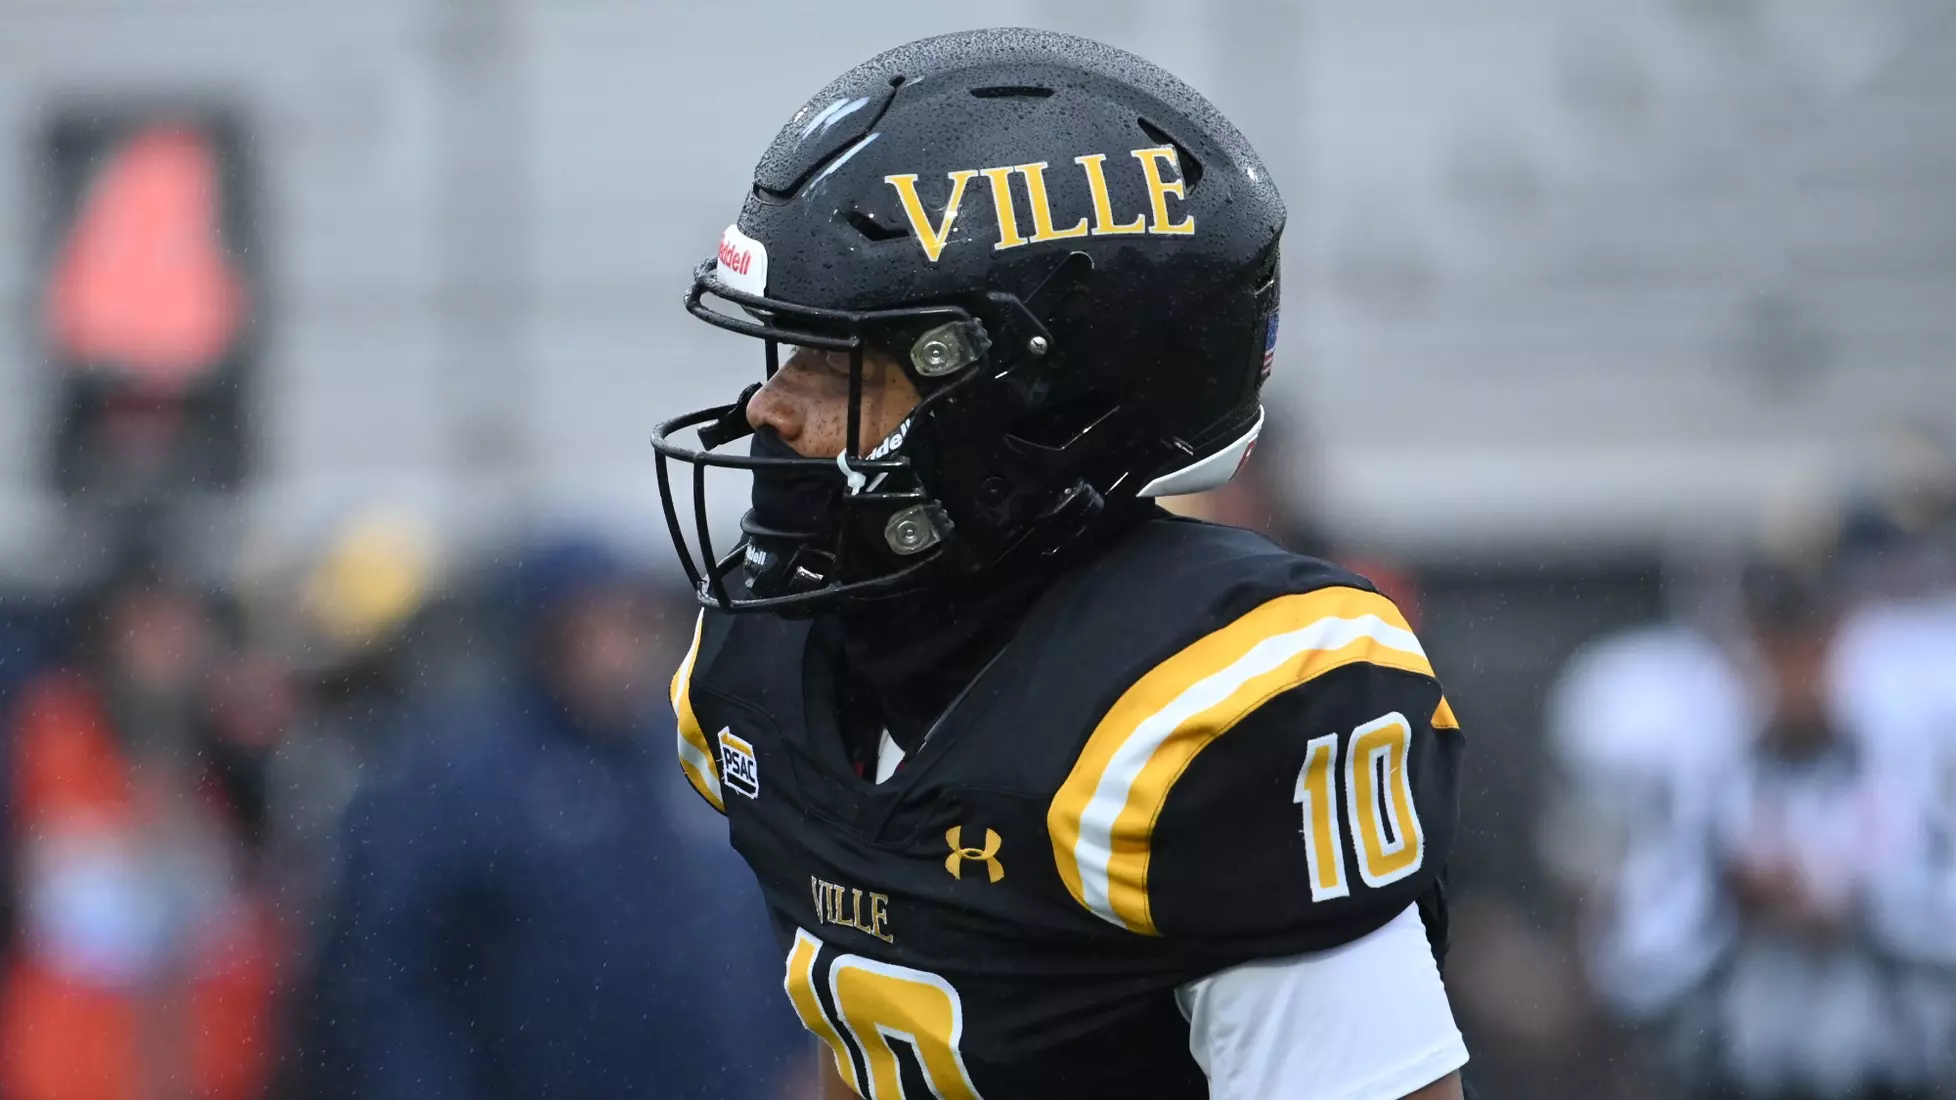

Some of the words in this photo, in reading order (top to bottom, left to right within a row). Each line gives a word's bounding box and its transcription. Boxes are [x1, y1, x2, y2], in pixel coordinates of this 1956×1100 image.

[885, 143, 1195, 262] VILLE
[723, 747, 756, 784] PSAC
[1293, 711, 1424, 902] 10
[811, 875, 894, 944] VILLE
